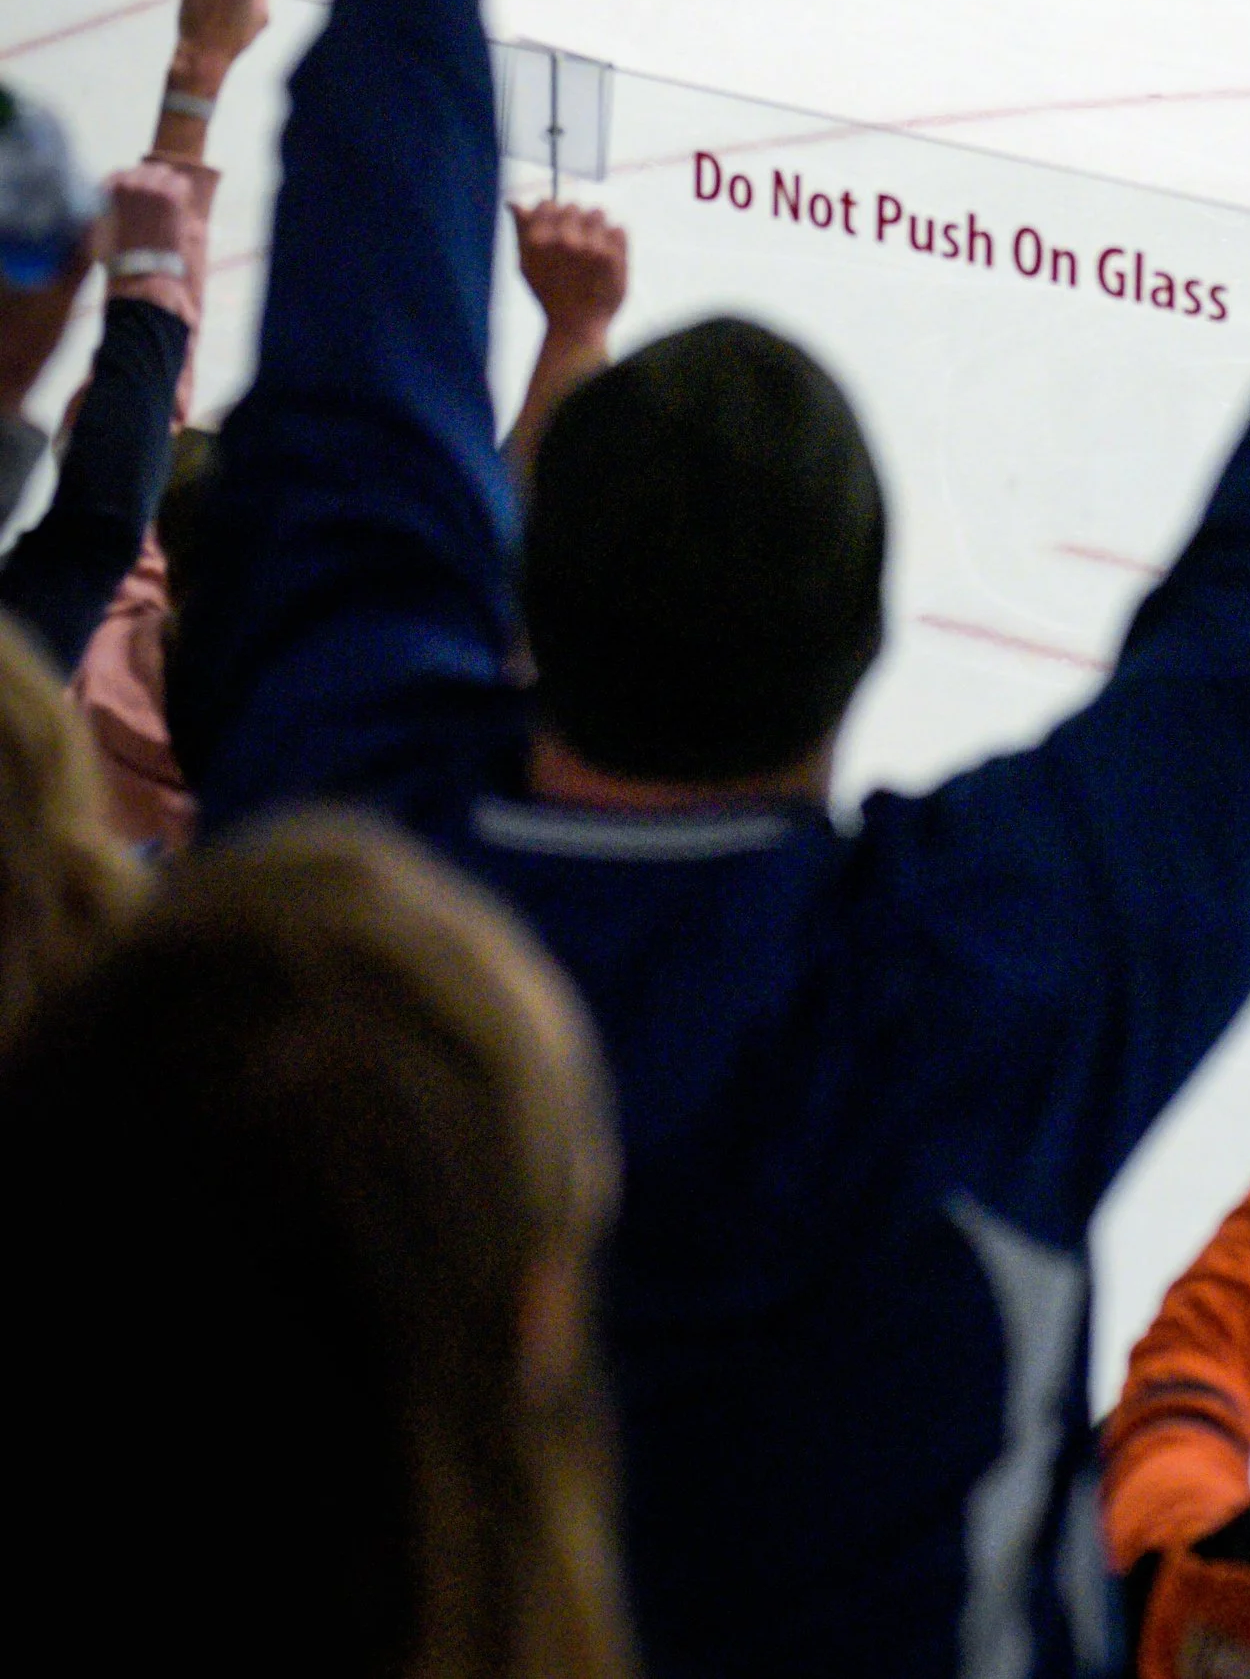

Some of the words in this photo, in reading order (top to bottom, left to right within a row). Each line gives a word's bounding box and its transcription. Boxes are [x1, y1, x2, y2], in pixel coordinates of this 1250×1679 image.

[693, 150, 753, 210] Do
[772, 169, 858, 236] Not
[876, 193, 993, 268] Push
[1013, 227, 1078, 287] On
[1097, 247, 1228, 322] Glass
